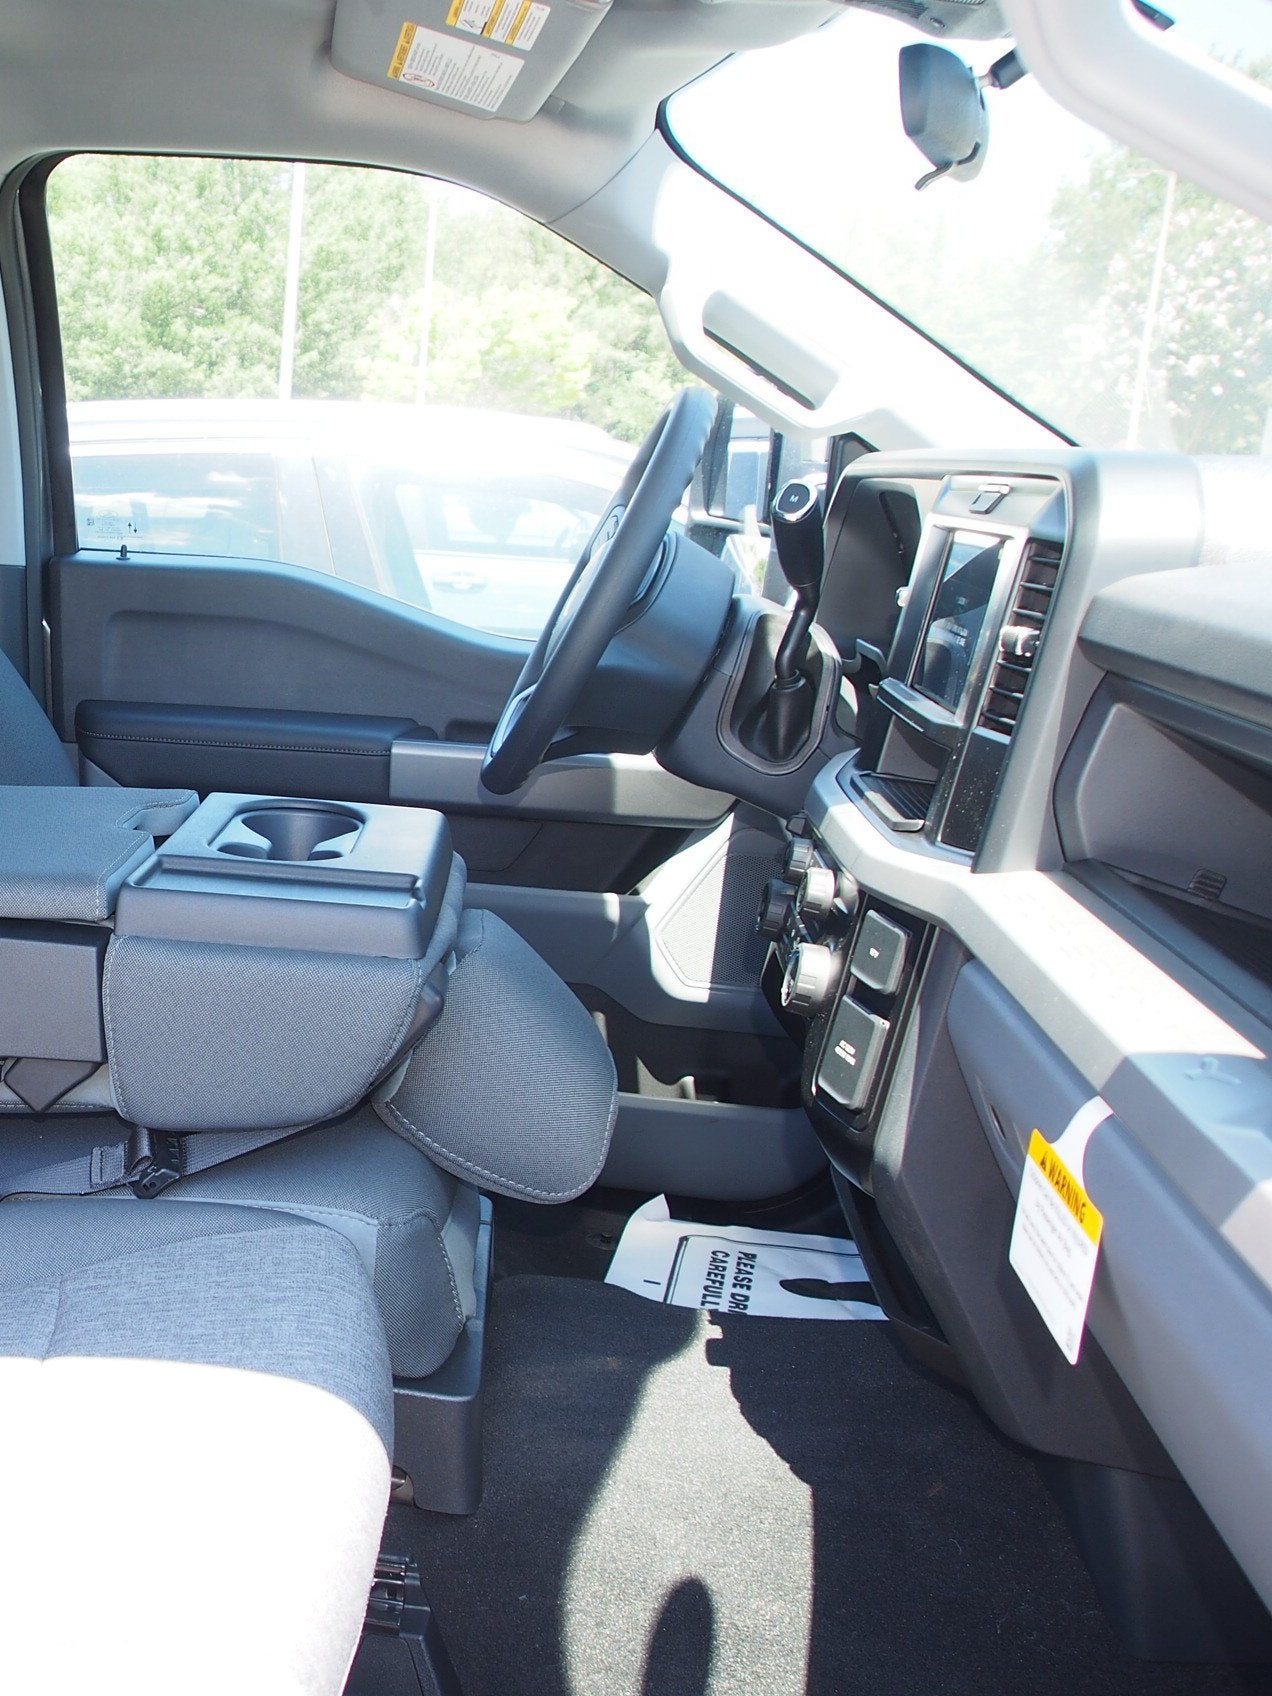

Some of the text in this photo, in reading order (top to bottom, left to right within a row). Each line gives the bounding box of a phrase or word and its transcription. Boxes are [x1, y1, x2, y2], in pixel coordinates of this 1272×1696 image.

[1049, 1158, 1086, 1223] WARNING
[700, 1250, 730, 1309] CAREFULL
[732, 1251, 757, 1291] PLEASE
